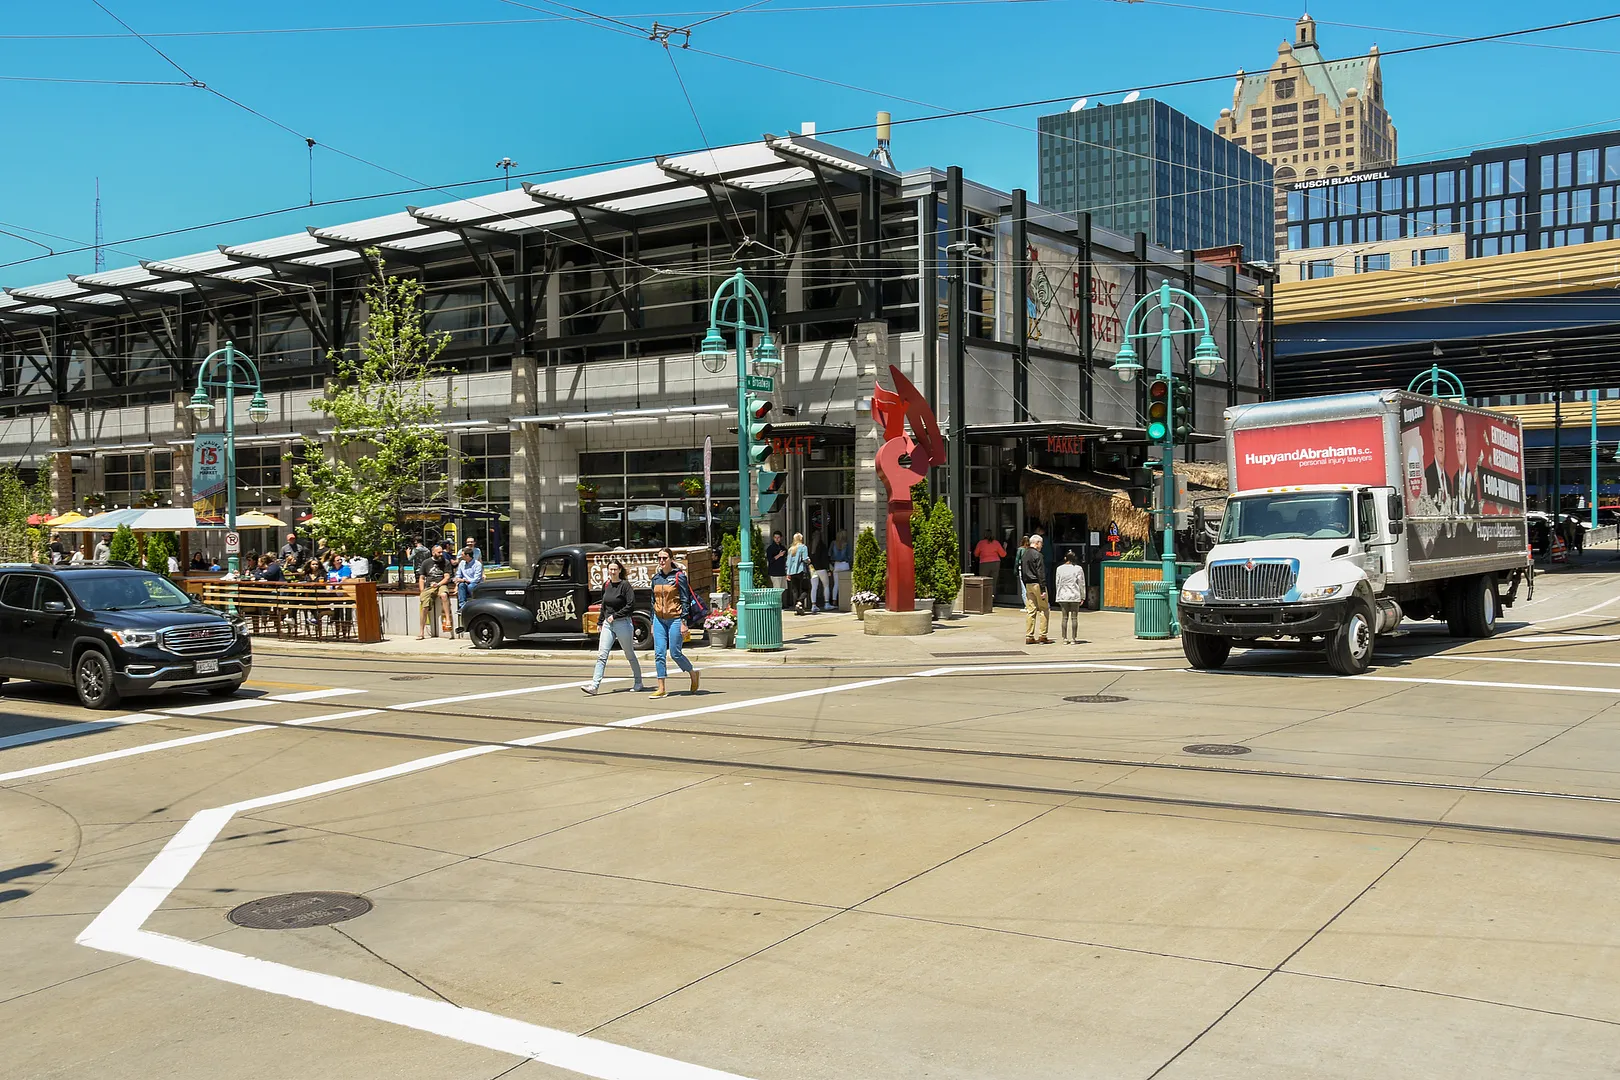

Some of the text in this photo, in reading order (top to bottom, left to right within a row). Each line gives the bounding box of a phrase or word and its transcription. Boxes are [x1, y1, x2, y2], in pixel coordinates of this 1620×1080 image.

[1294, 171, 1390, 190] HUSCH BLACKWELL
[1073, 272, 1117, 309] PBLIC
[1069, 308, 1120, 344] MRKET
[752, 376, 771, 391] Broadway
[196, 440, 222, 452] MILWAUKEE
[1047, 434, 1086, 455] MARKET
[201, 447, 218, 465] 15
[1245, 445, 1357, 466] HupyandAbraham
[1299, 454, 1373, 468] personal injury lawyers
[540, 597, 568, 612] DRAFT
